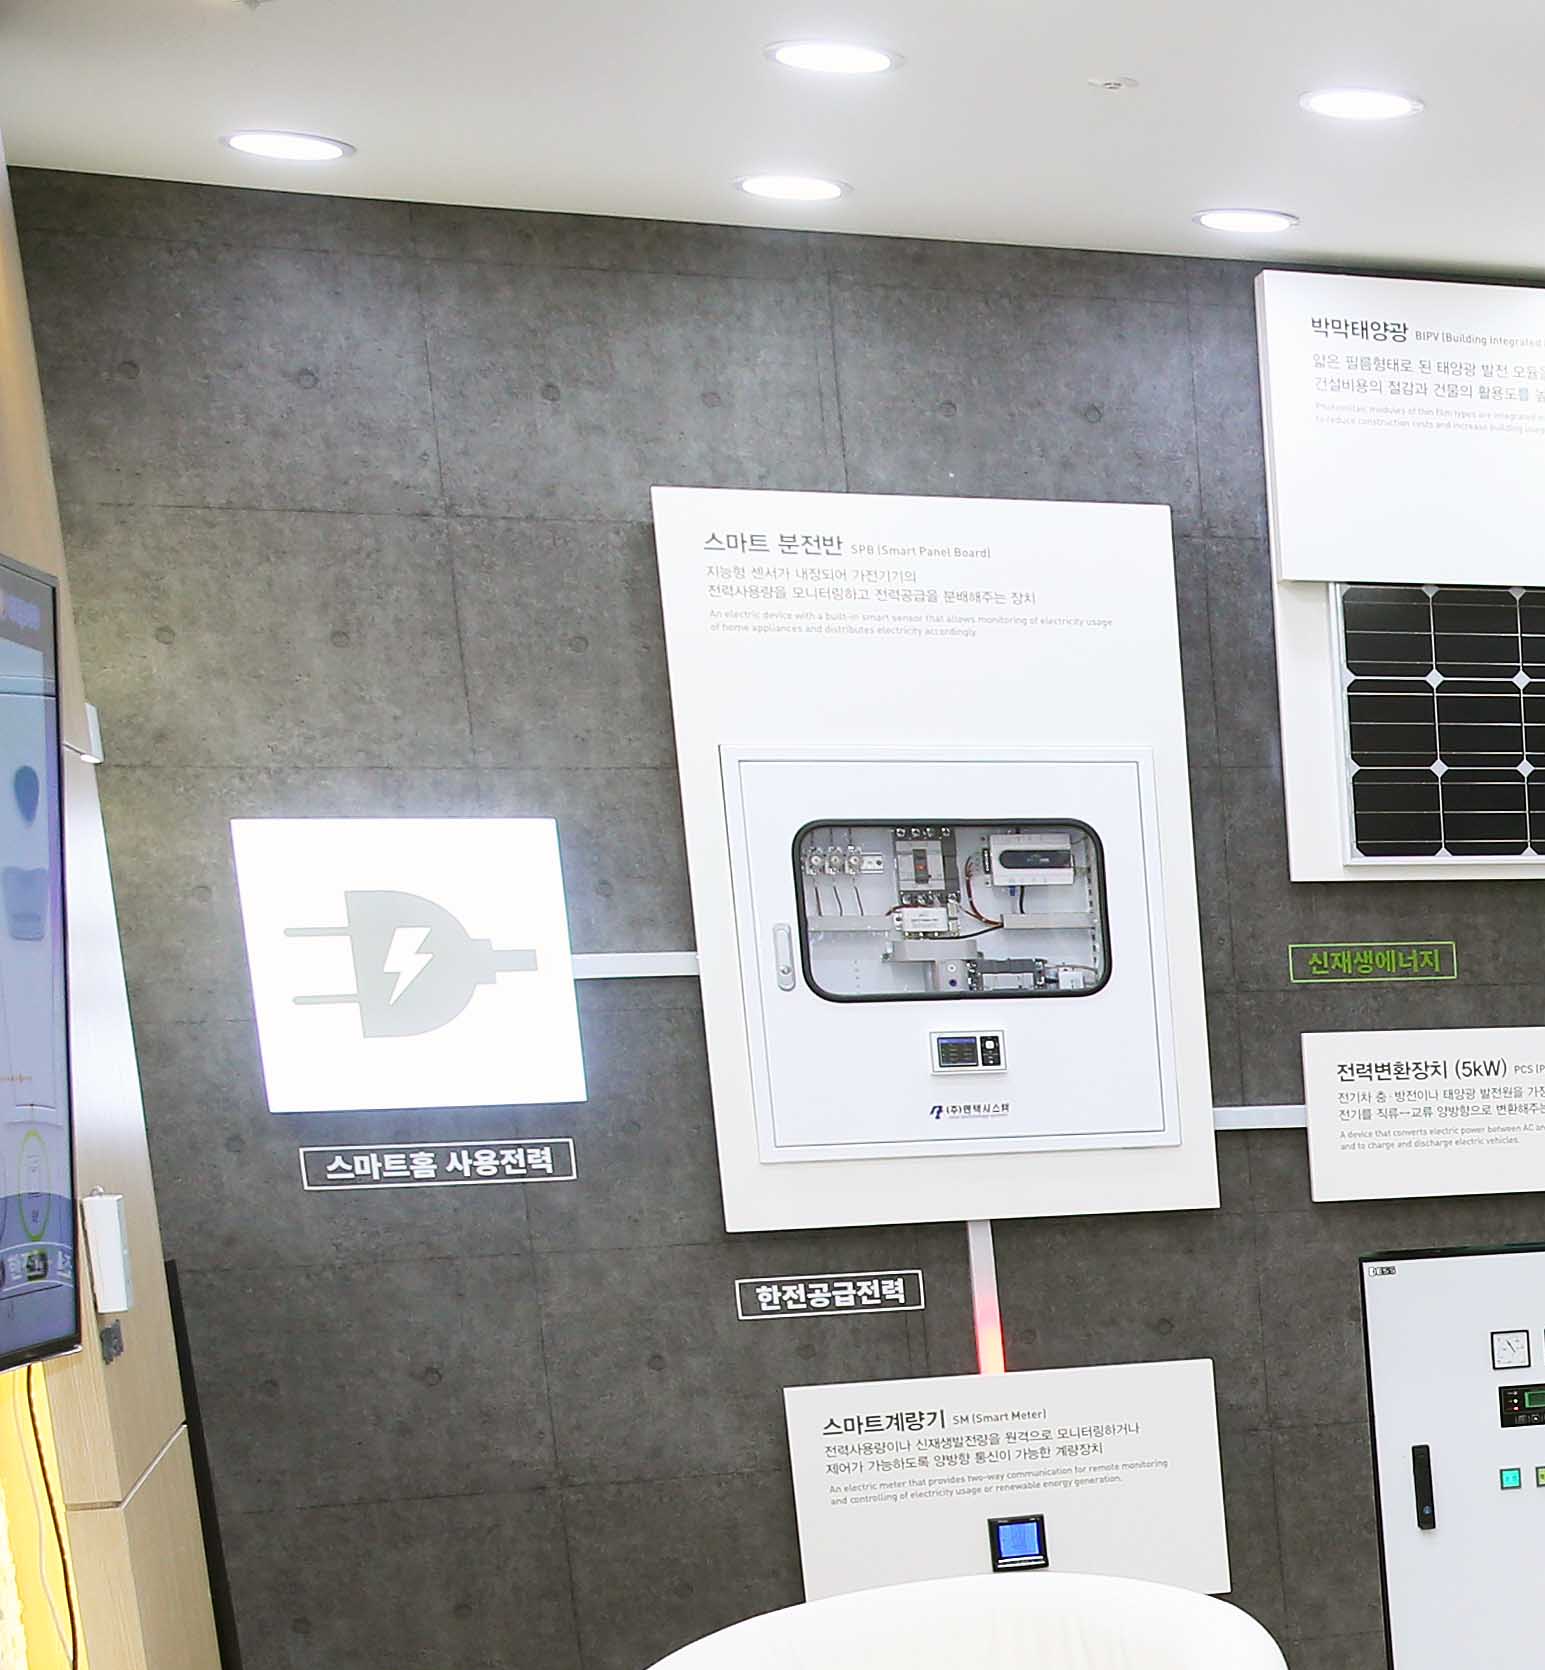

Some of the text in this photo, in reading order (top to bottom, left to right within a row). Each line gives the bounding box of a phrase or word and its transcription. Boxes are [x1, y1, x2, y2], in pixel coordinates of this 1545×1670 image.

[1311, 317, 1408, 343] 박막태양광
[1415, 330, 1439, 342] BIPV
[1436, 361, 1475, 376] 태양광
[704, 533, 770, 552] 스마트
[778, 534, 843, 555] 분전반
[851, 544, 874, 555] SPB
[919, 546, 950, 558] Panel
[707, 565, 917, 584] 지능형 센서가 내장되어 가전기기의
[793, 586, 870, 601] 모니터링하고
[1011, 592, 1036, 605] 장치
[1309, 949, 1440, 975] 신재생에너지
[1337, 1060, 1448, 1082] 전력변환장치
[1455, 1057, 1507, 1080] (5kW)
[1514, 1065, 1533, 1075] PCS
[1338, 1091, 1372, 1104] 전기차
[1443, 1088, 1475, 1101] 태양광
[1480, 1086, 1523, 1099] 발전원을
[1338, 1108, 1372, 1121] 전기를
[1437, 1105, 1492, 1117] 양방향으로
[326, 1147, 554, 1180] 스마트홈 사용전력
[755, 1278, 905, 1311] 한전공급전력
[822, 1409, 945, 1436] 스마트계량기
[953, 1415, 969, 1425] SM
[825, 1440, 911, 1458] 전력사용량이나
[1005, 1429, 1053, 1444] 원격으로
[1057, 1422, 1140, 1440] 모니터링하거나
[826, 1461, 863, 1475] 제어가
[933, 1453, 970, 1468] 양방향
[975, 1450, 1011, 1465] 통신이
[1015, 1446, 1051, 1461] 가능한
[1055, 1442, 1103, 1458] 계량장치
